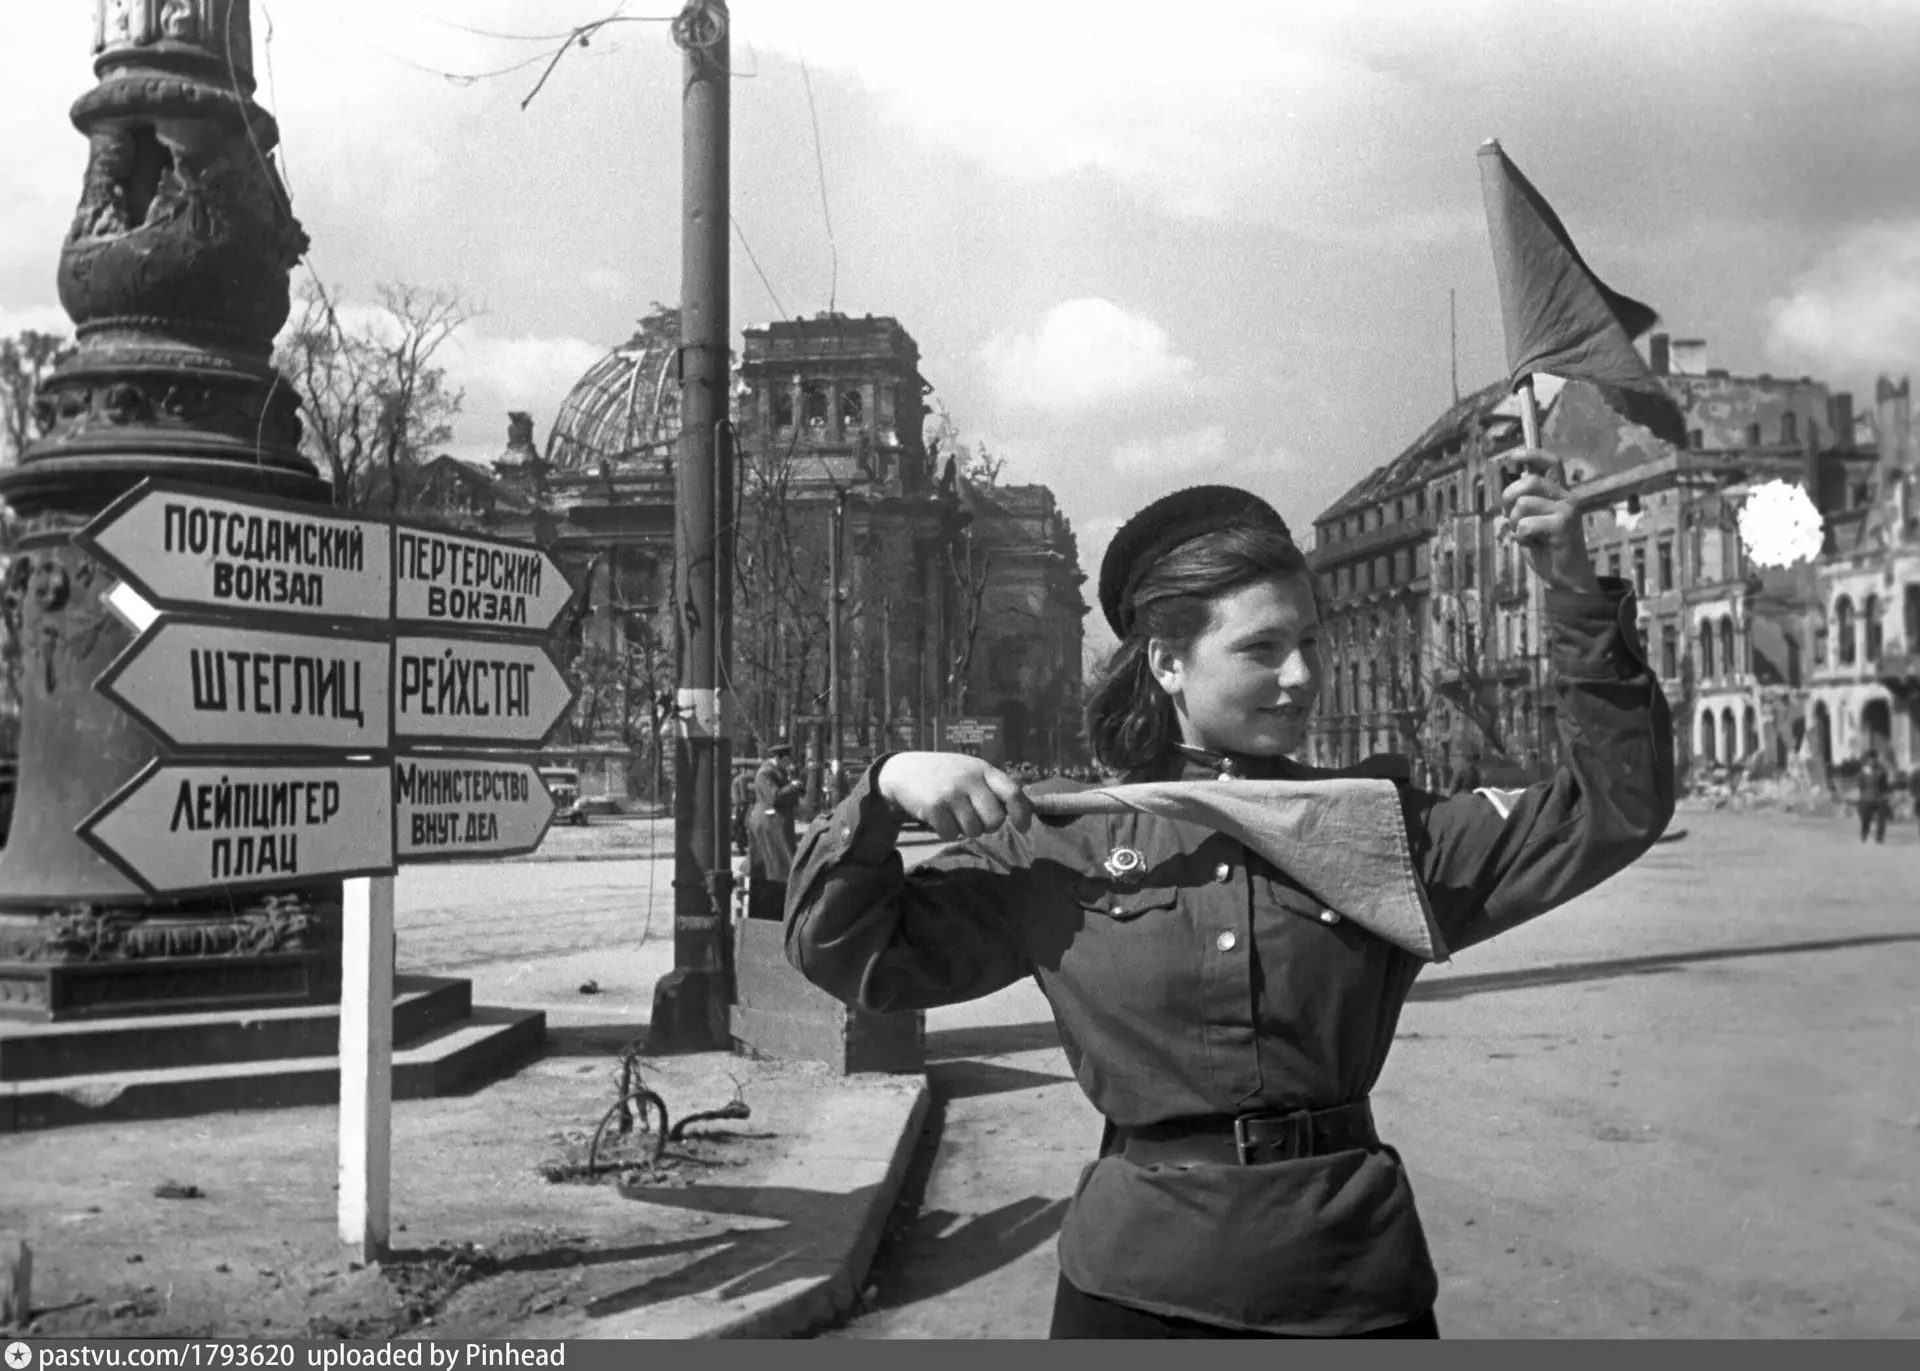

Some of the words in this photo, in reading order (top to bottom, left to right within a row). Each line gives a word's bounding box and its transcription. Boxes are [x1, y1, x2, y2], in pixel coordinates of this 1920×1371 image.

[164, 504, 364, 571] ПОТСДАМСКИЙ
[399, 534, 541, 597] ПЕРТЕРСКИЙ
[213, 562, 324, 607] ВОКЗАЛ
[428, 586, 526, 625] ВОКЗАЛ
[190, 649, 365, 728] ШТЕГЛИЦ
[401, 648, 535, 717] РЕЙХСТАГ
[170, 775, 340, 833] ЛЕЙПЦИГЕР
[211, 836, 298, 879] ПЛАЦ
